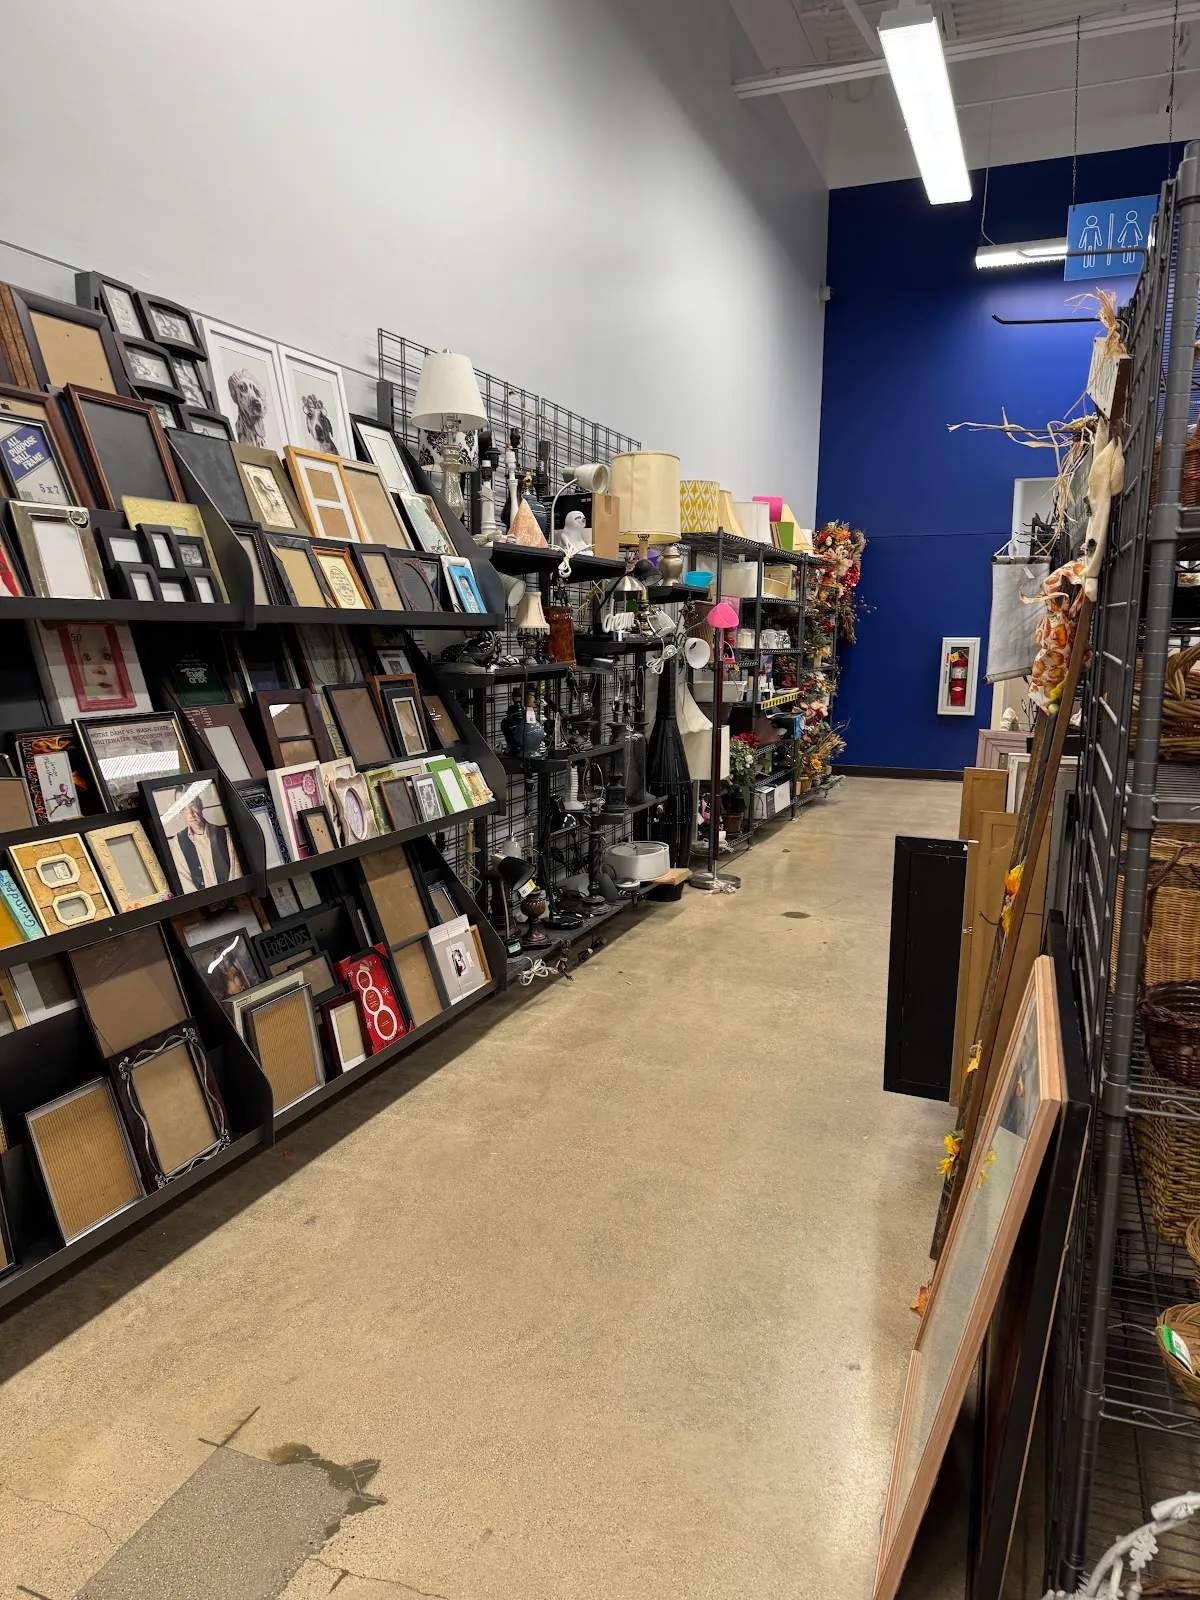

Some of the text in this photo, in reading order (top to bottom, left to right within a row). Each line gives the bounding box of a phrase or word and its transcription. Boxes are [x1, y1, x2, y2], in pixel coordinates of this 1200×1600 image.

[6, 436, 21, 449] ALL
[8, 435, 38, 458] PURPOSE
[12, 451, 32, 465] WALL
[22, 452, 45, 470] FRAME
